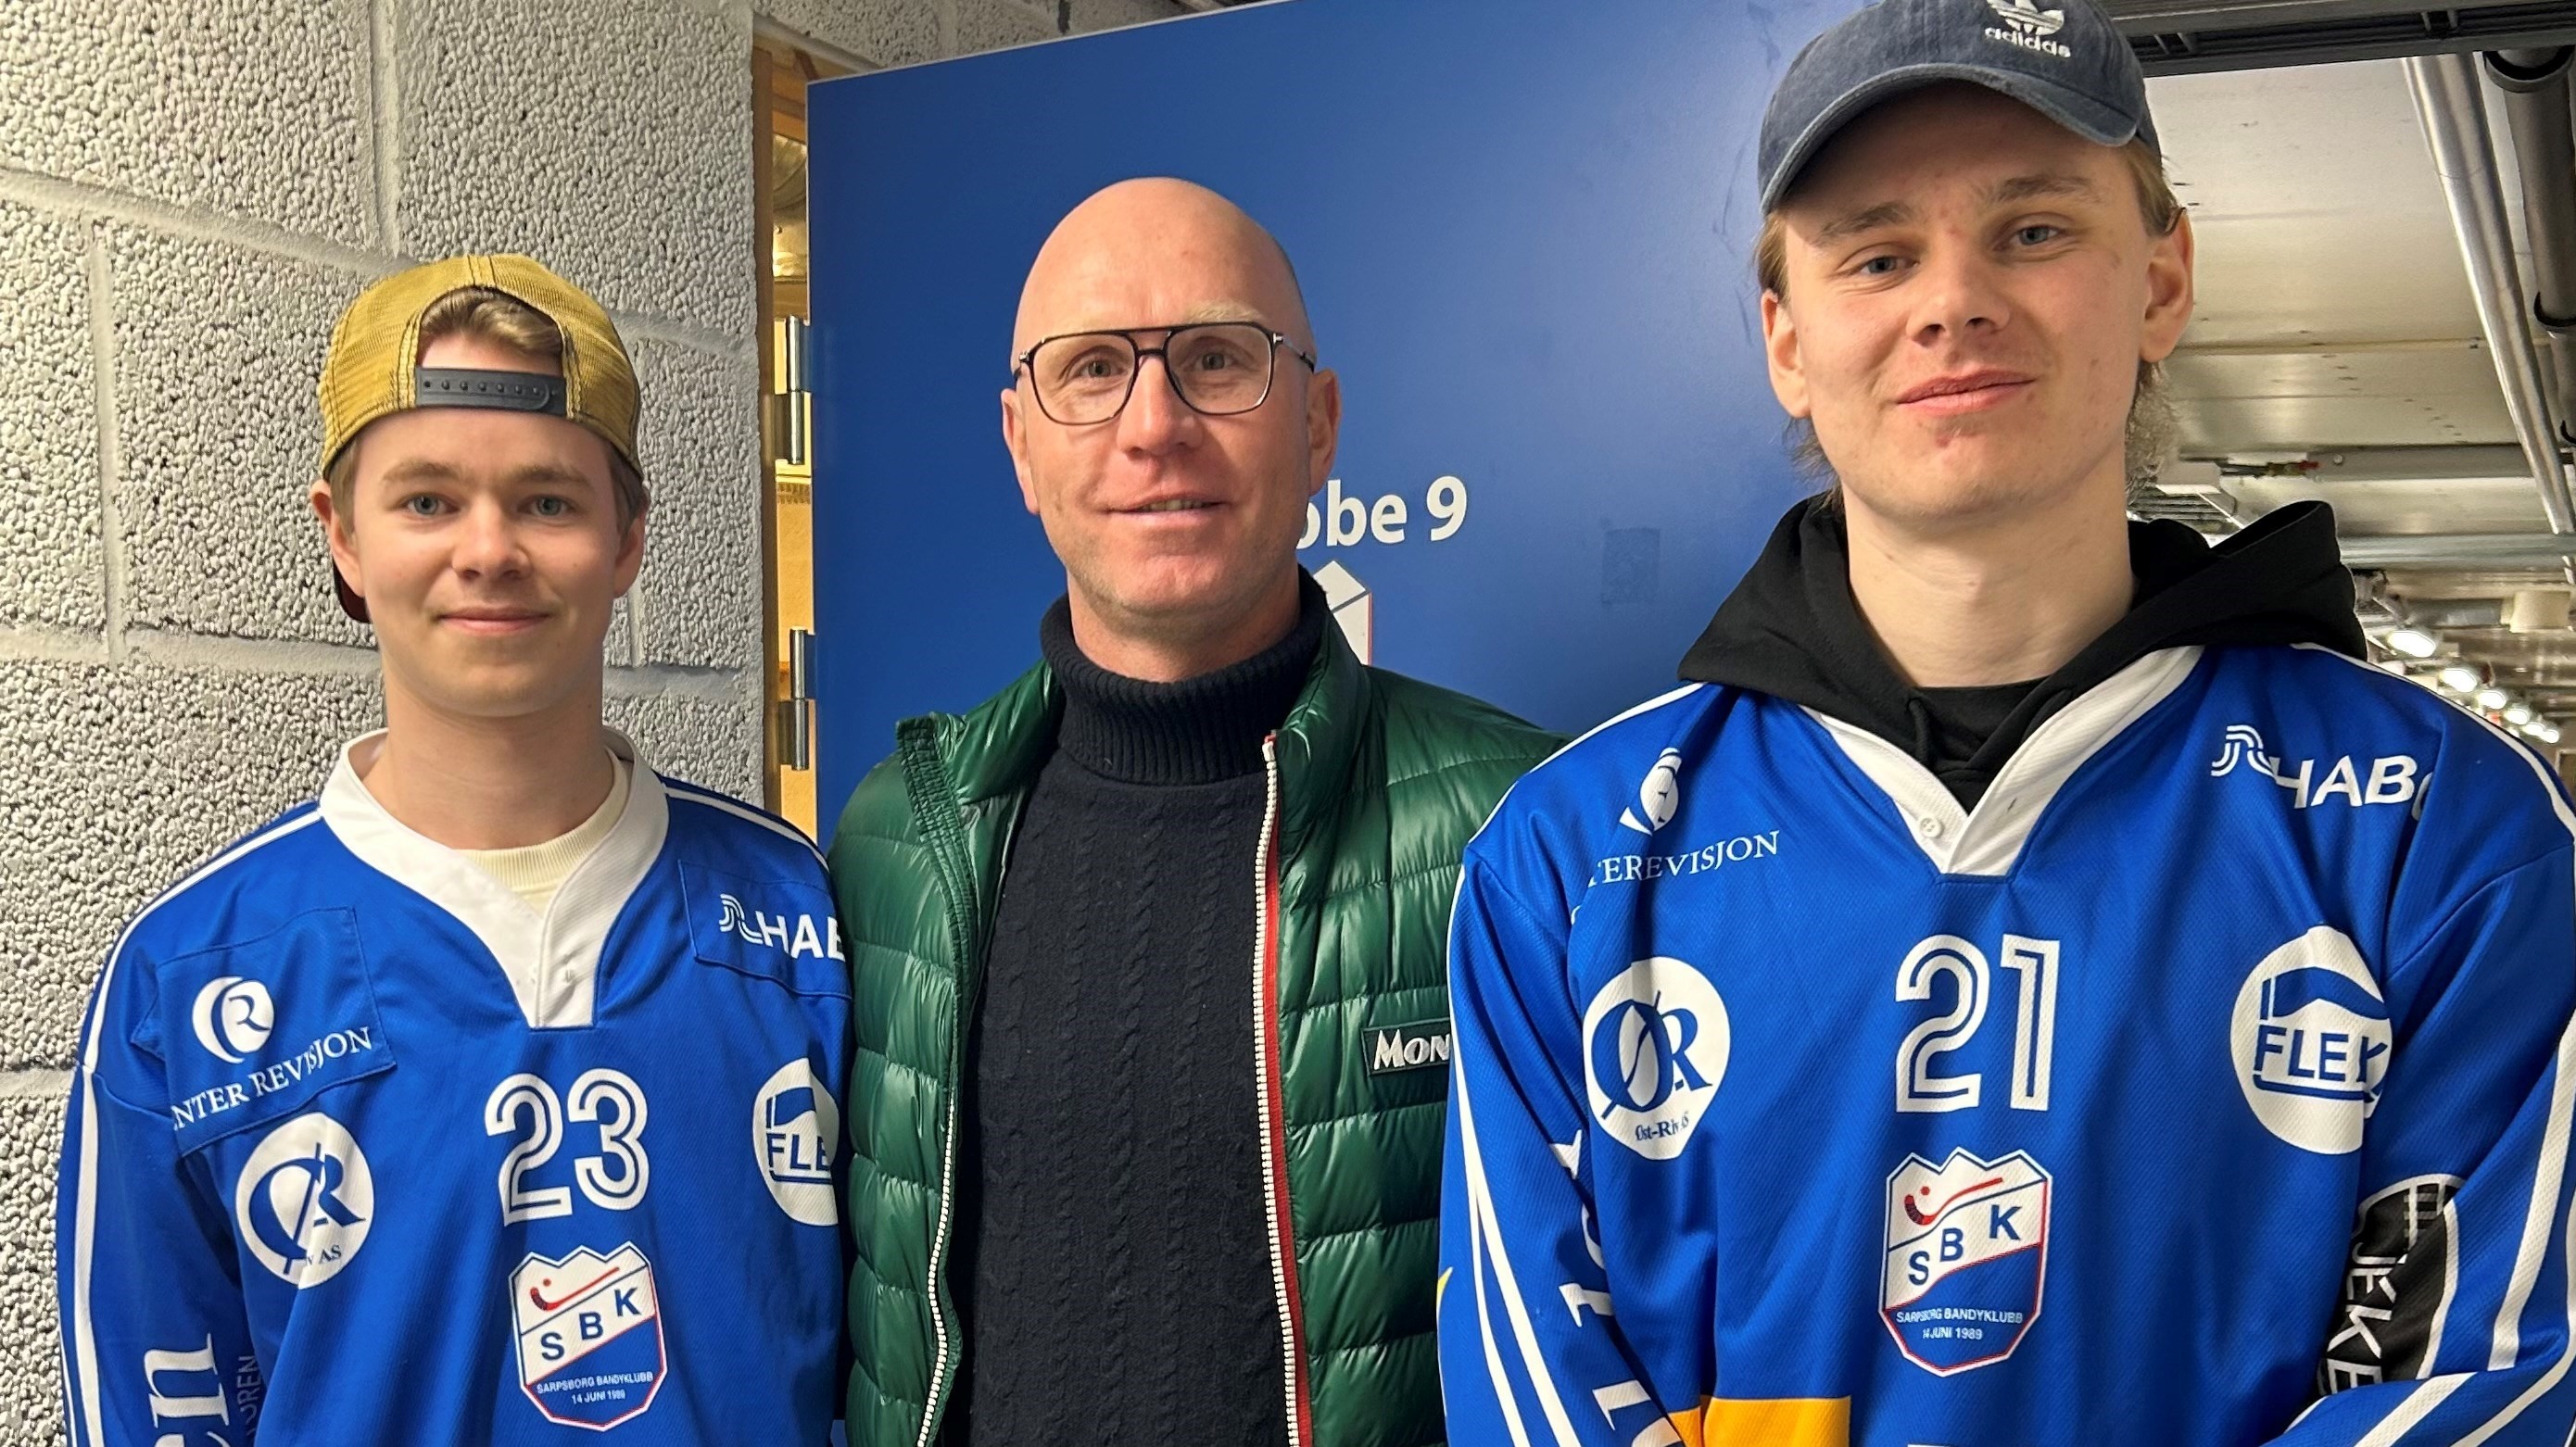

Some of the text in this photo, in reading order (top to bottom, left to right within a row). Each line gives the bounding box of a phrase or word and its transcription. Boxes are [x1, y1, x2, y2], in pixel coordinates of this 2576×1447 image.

[1985, 27, 2072, 57] adidas
[1426, 475, 1468, 542] 9
[1895, 934, 2060, 1113] 21
[247, 1025, 373, 1098] REVISJON
[485, 1067, 650, 1227] 23
[1943, 1307, 2024, 1325] BANDYKLUBB
[1955, 1327, 1984, 1341] 1989
[537, 1371, 654, 1394] SARPSBORG BANDYKLUBB
[571, 1392, 584, 1405] 14
[584, 1390, 607, 1403] JUNI
